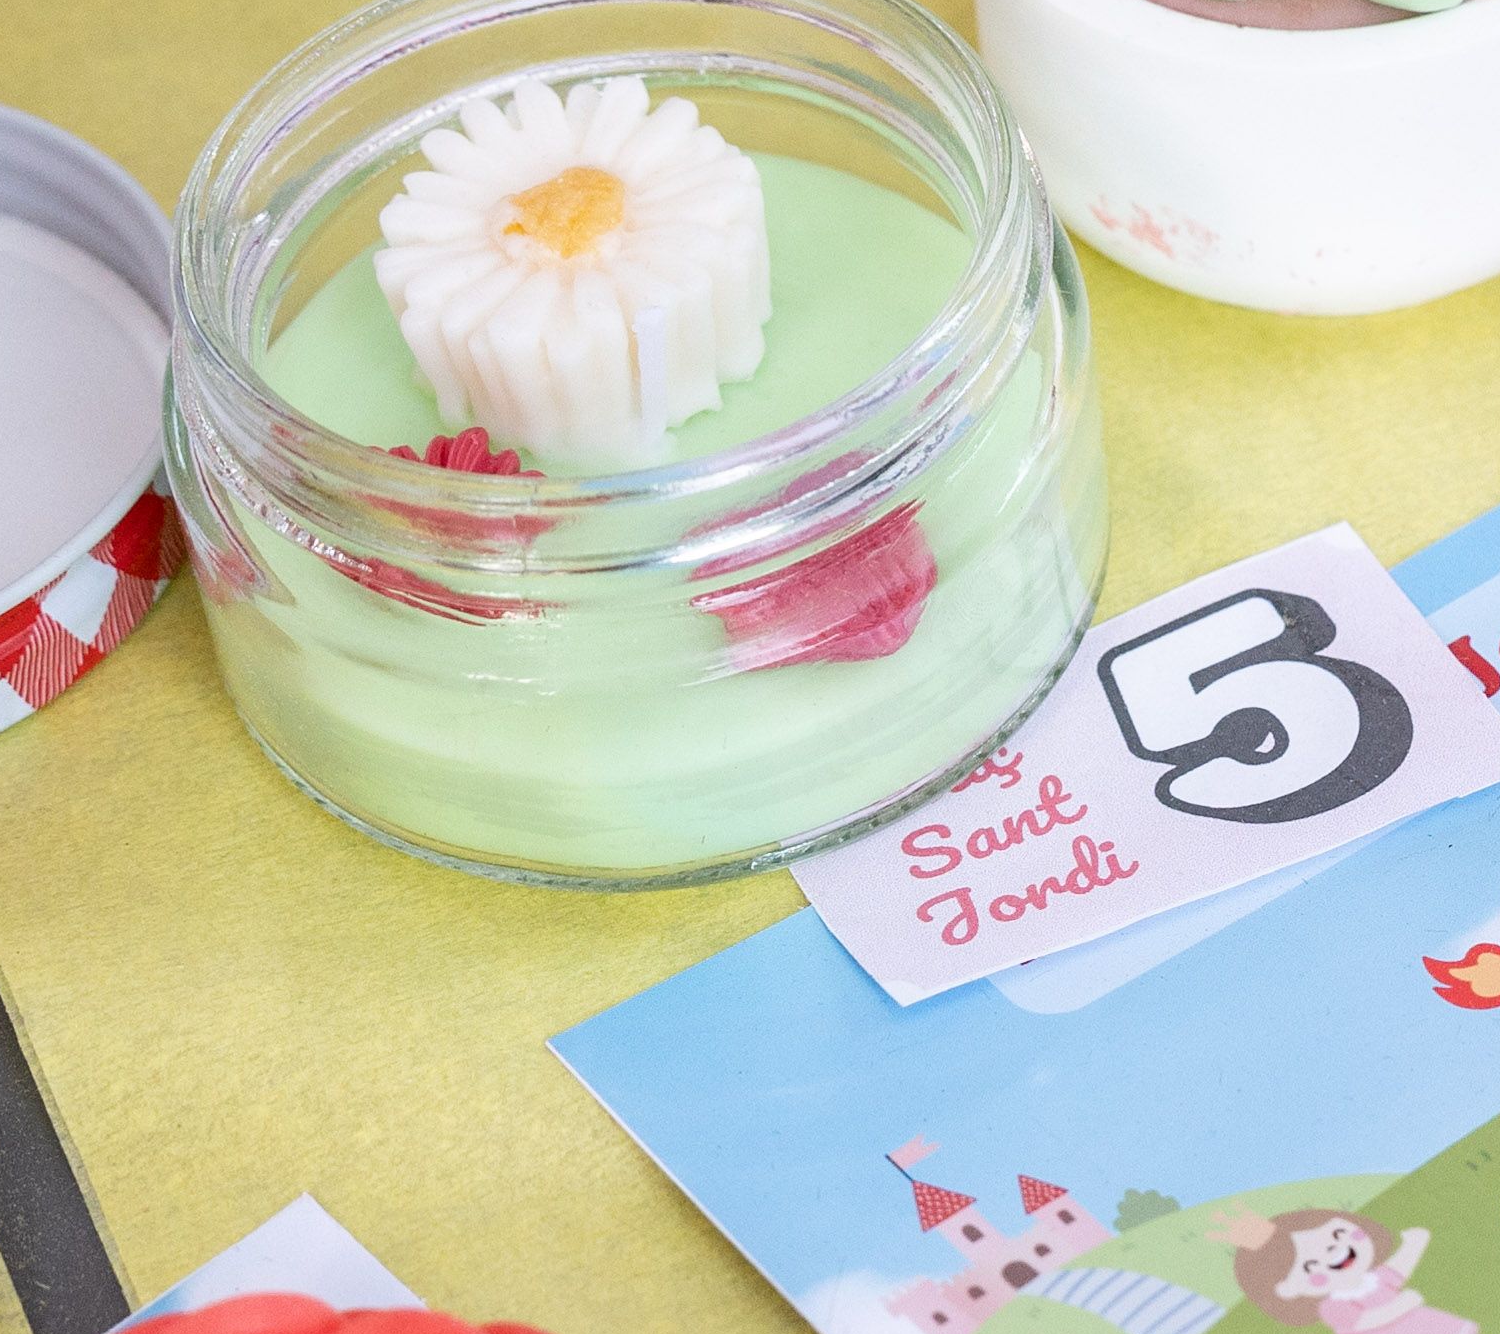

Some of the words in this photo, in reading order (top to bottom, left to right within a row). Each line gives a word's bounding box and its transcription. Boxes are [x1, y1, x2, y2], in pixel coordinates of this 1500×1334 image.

[1096, 586, 1415, 824] 5
[900, 774, 1089, 880] Sant
[915, 834, 1140, 947] Jordi
